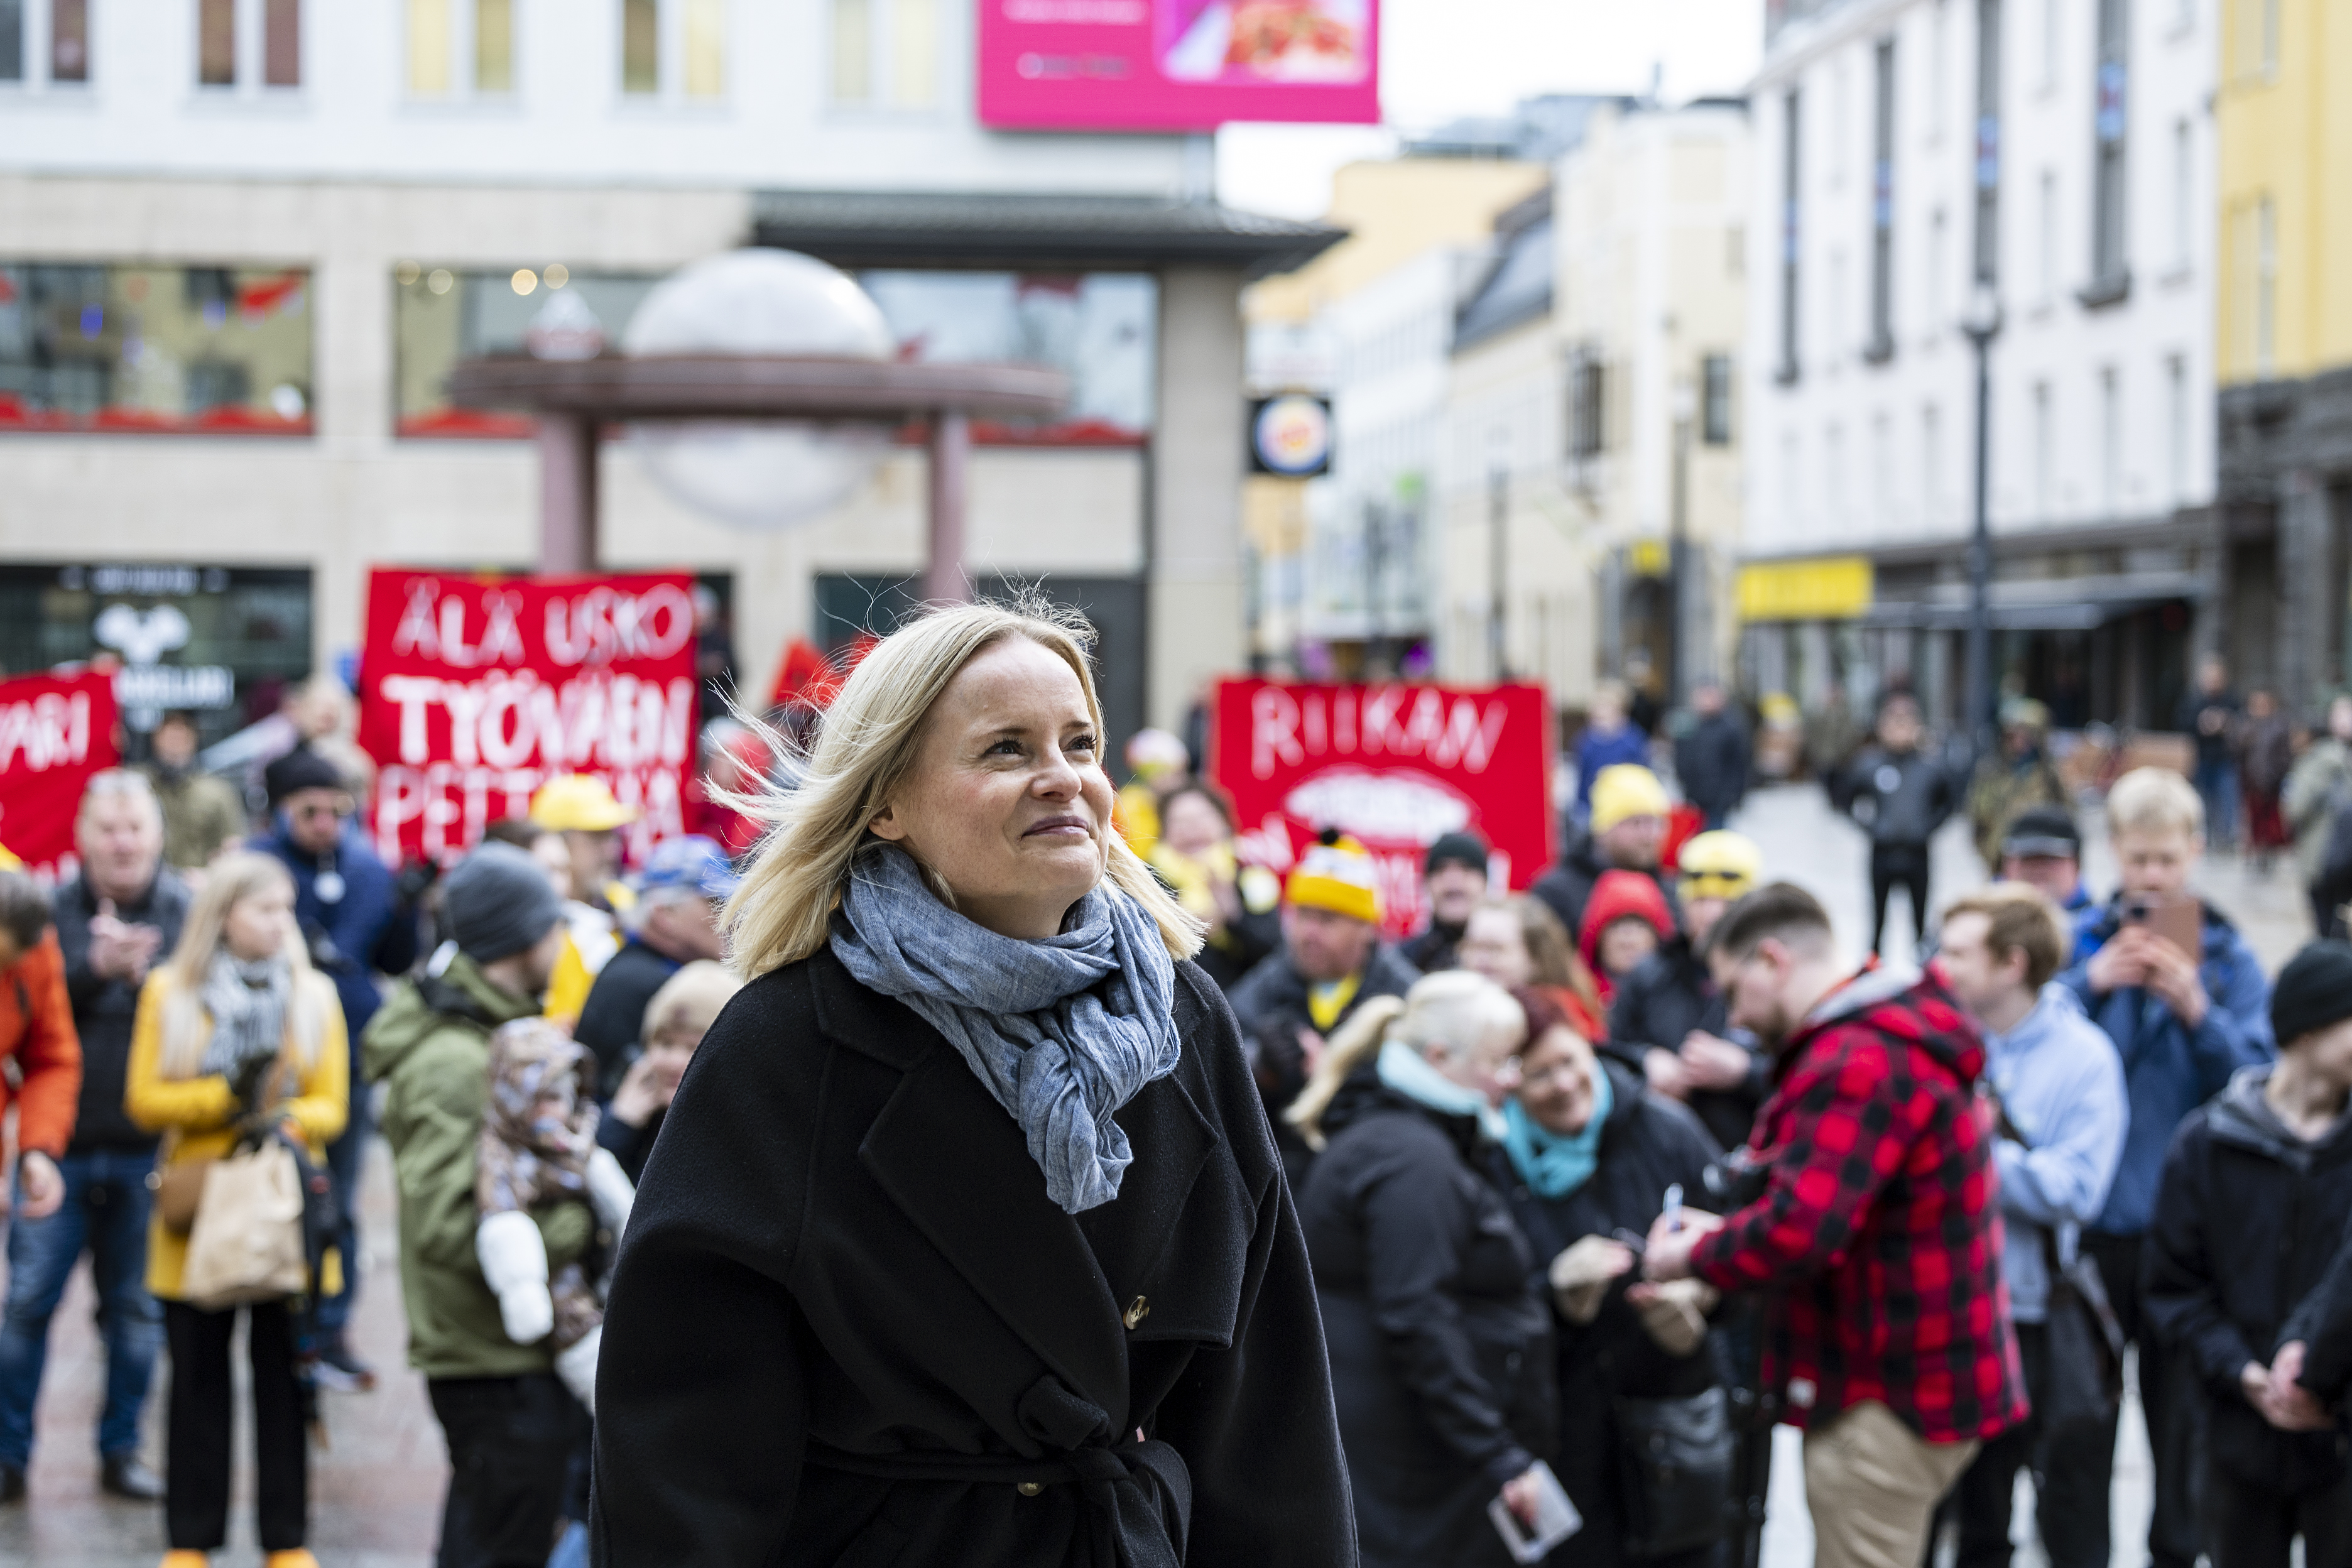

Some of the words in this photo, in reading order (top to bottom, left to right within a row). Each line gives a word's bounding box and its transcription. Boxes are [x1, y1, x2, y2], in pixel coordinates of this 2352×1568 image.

[392, 577, 525, 667] ÄLÄ
[545, 584, 692, 666] USKO
[1251, 685, 1508, 778] RIIKAN
